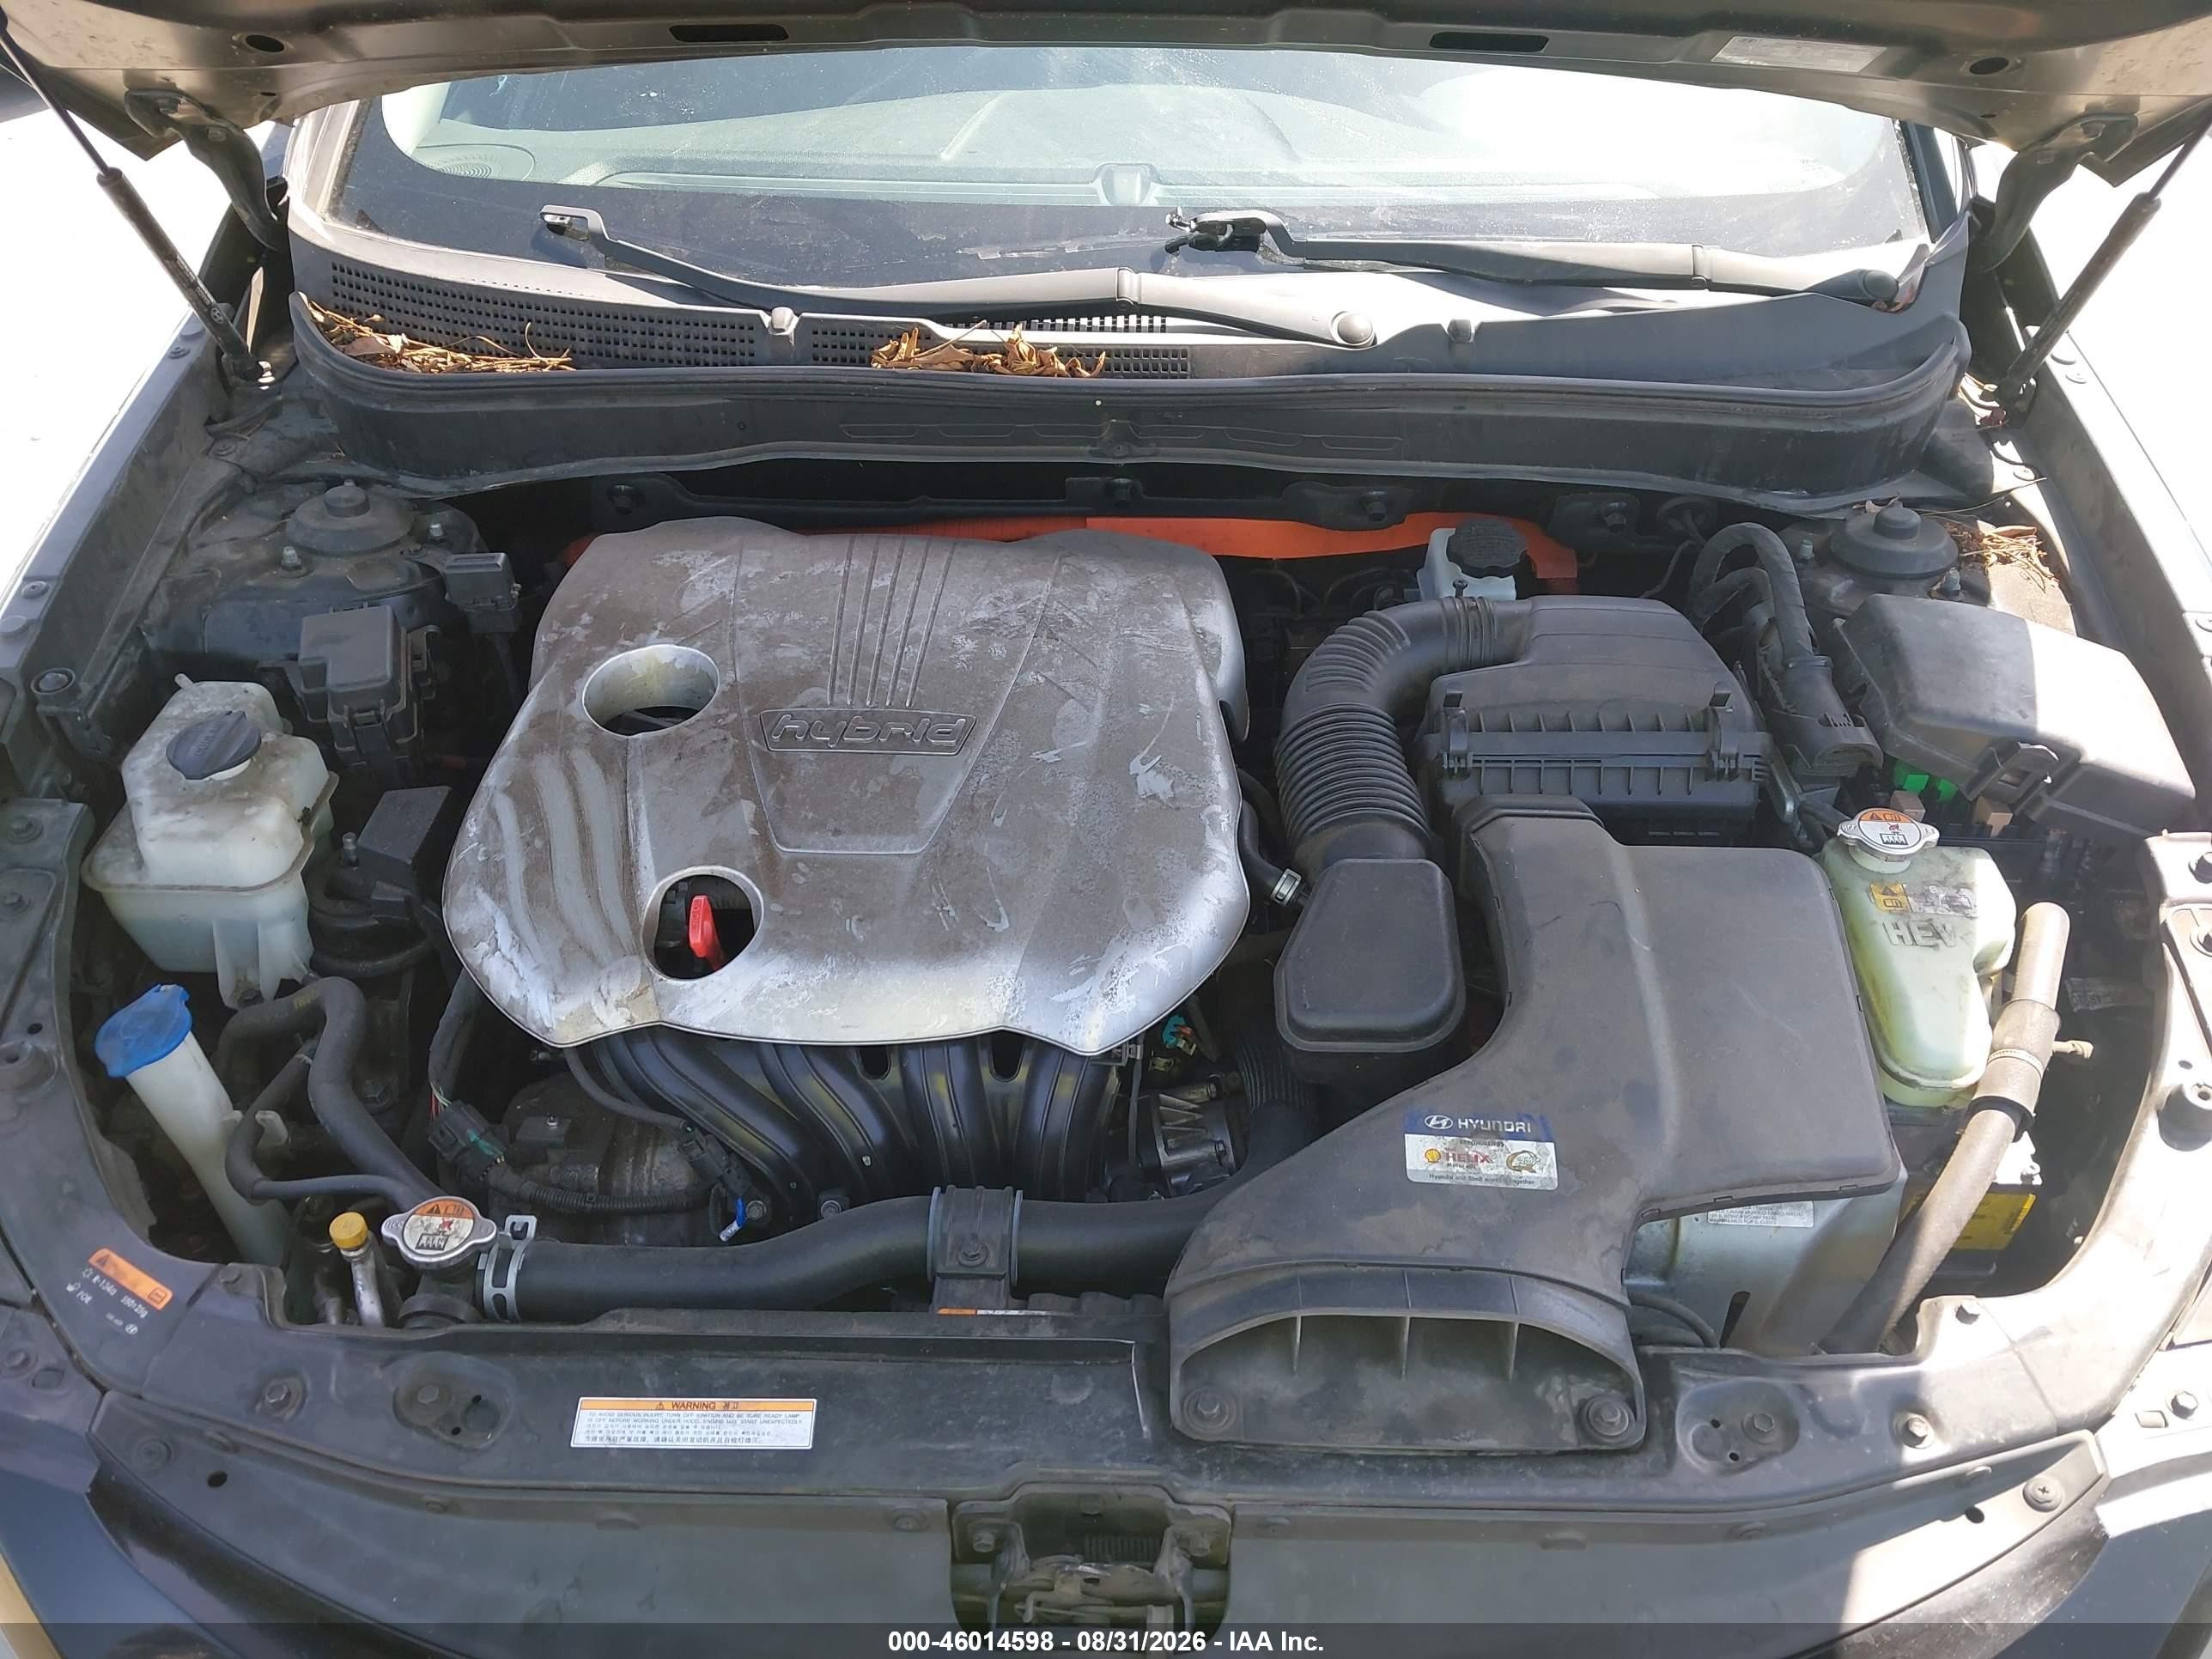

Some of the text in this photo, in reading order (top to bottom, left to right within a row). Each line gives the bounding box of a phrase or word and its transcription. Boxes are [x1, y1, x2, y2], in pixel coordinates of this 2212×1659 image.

[772, 714, 967, 748] hybrid
[1882, 919, 1957, 948] HEV
[1458, 1117, 1531, 1133] HYUNDAI
[1445, 1152, 1494, 1164] HELIX
[672, 1401, 716, 1410] WARNING
